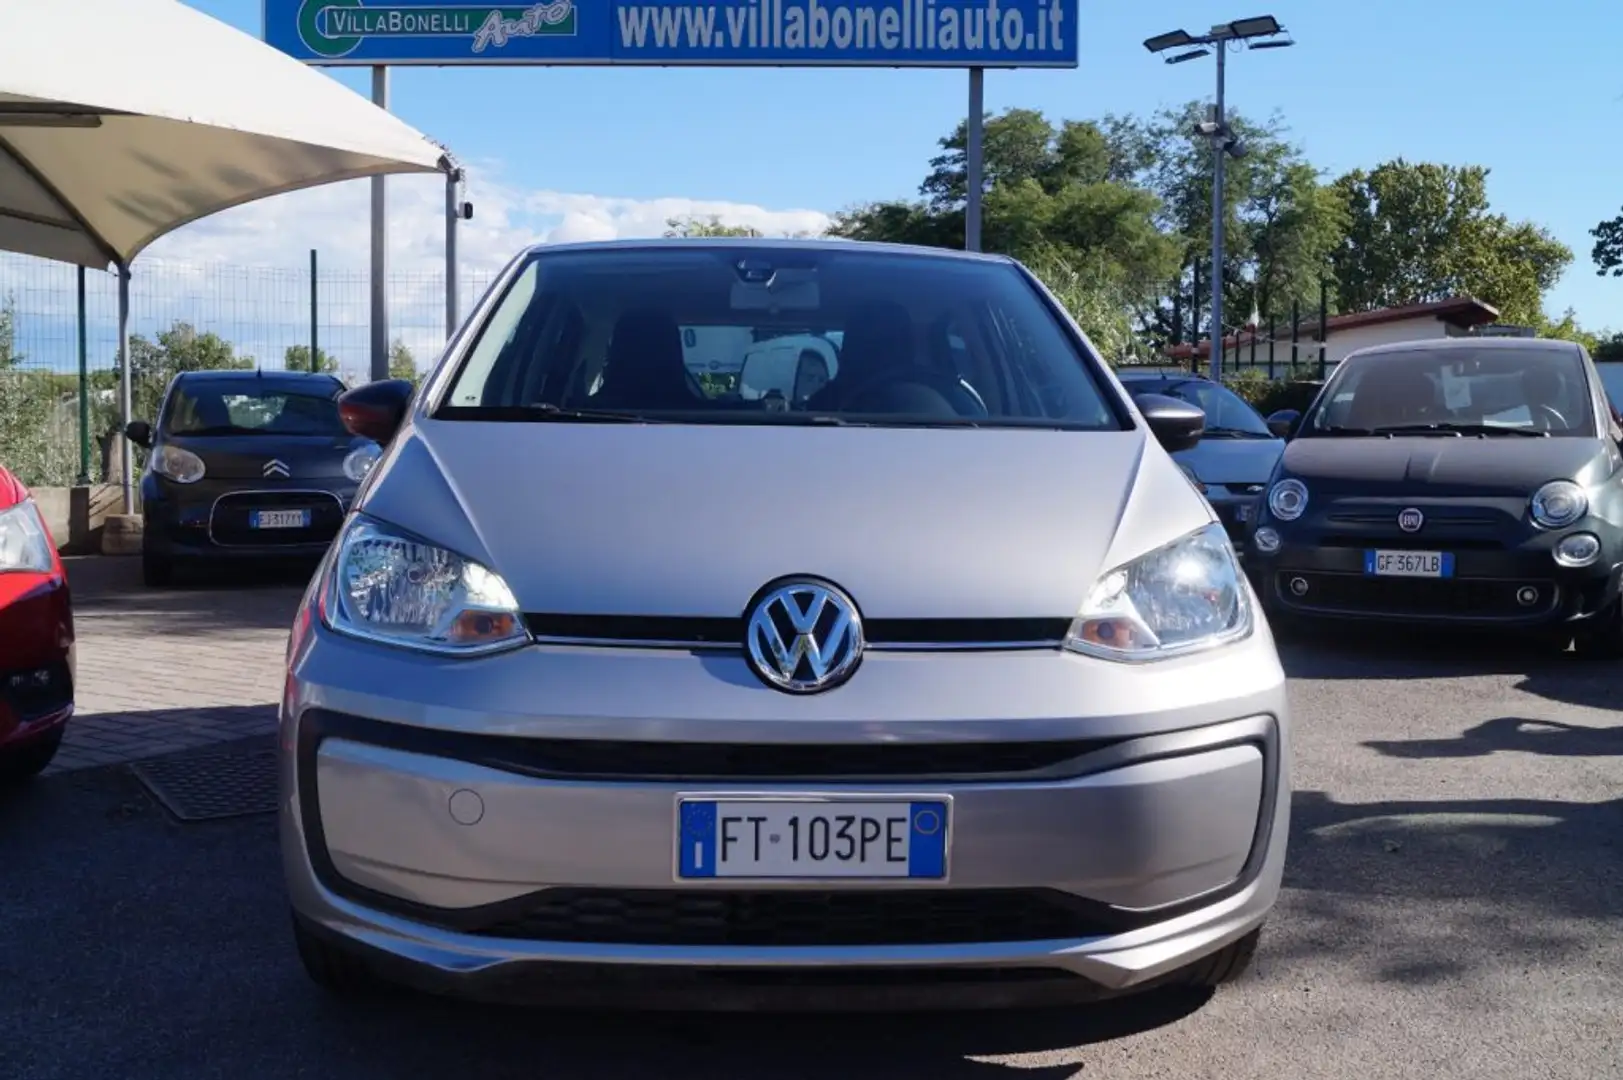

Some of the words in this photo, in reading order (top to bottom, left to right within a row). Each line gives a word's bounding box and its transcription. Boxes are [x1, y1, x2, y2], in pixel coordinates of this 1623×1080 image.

[617, 0, 1063, 51] www.villabonelliauto.it
[720, 816, 768, 863] FT
[788, 815, 908, 864] 103PE
